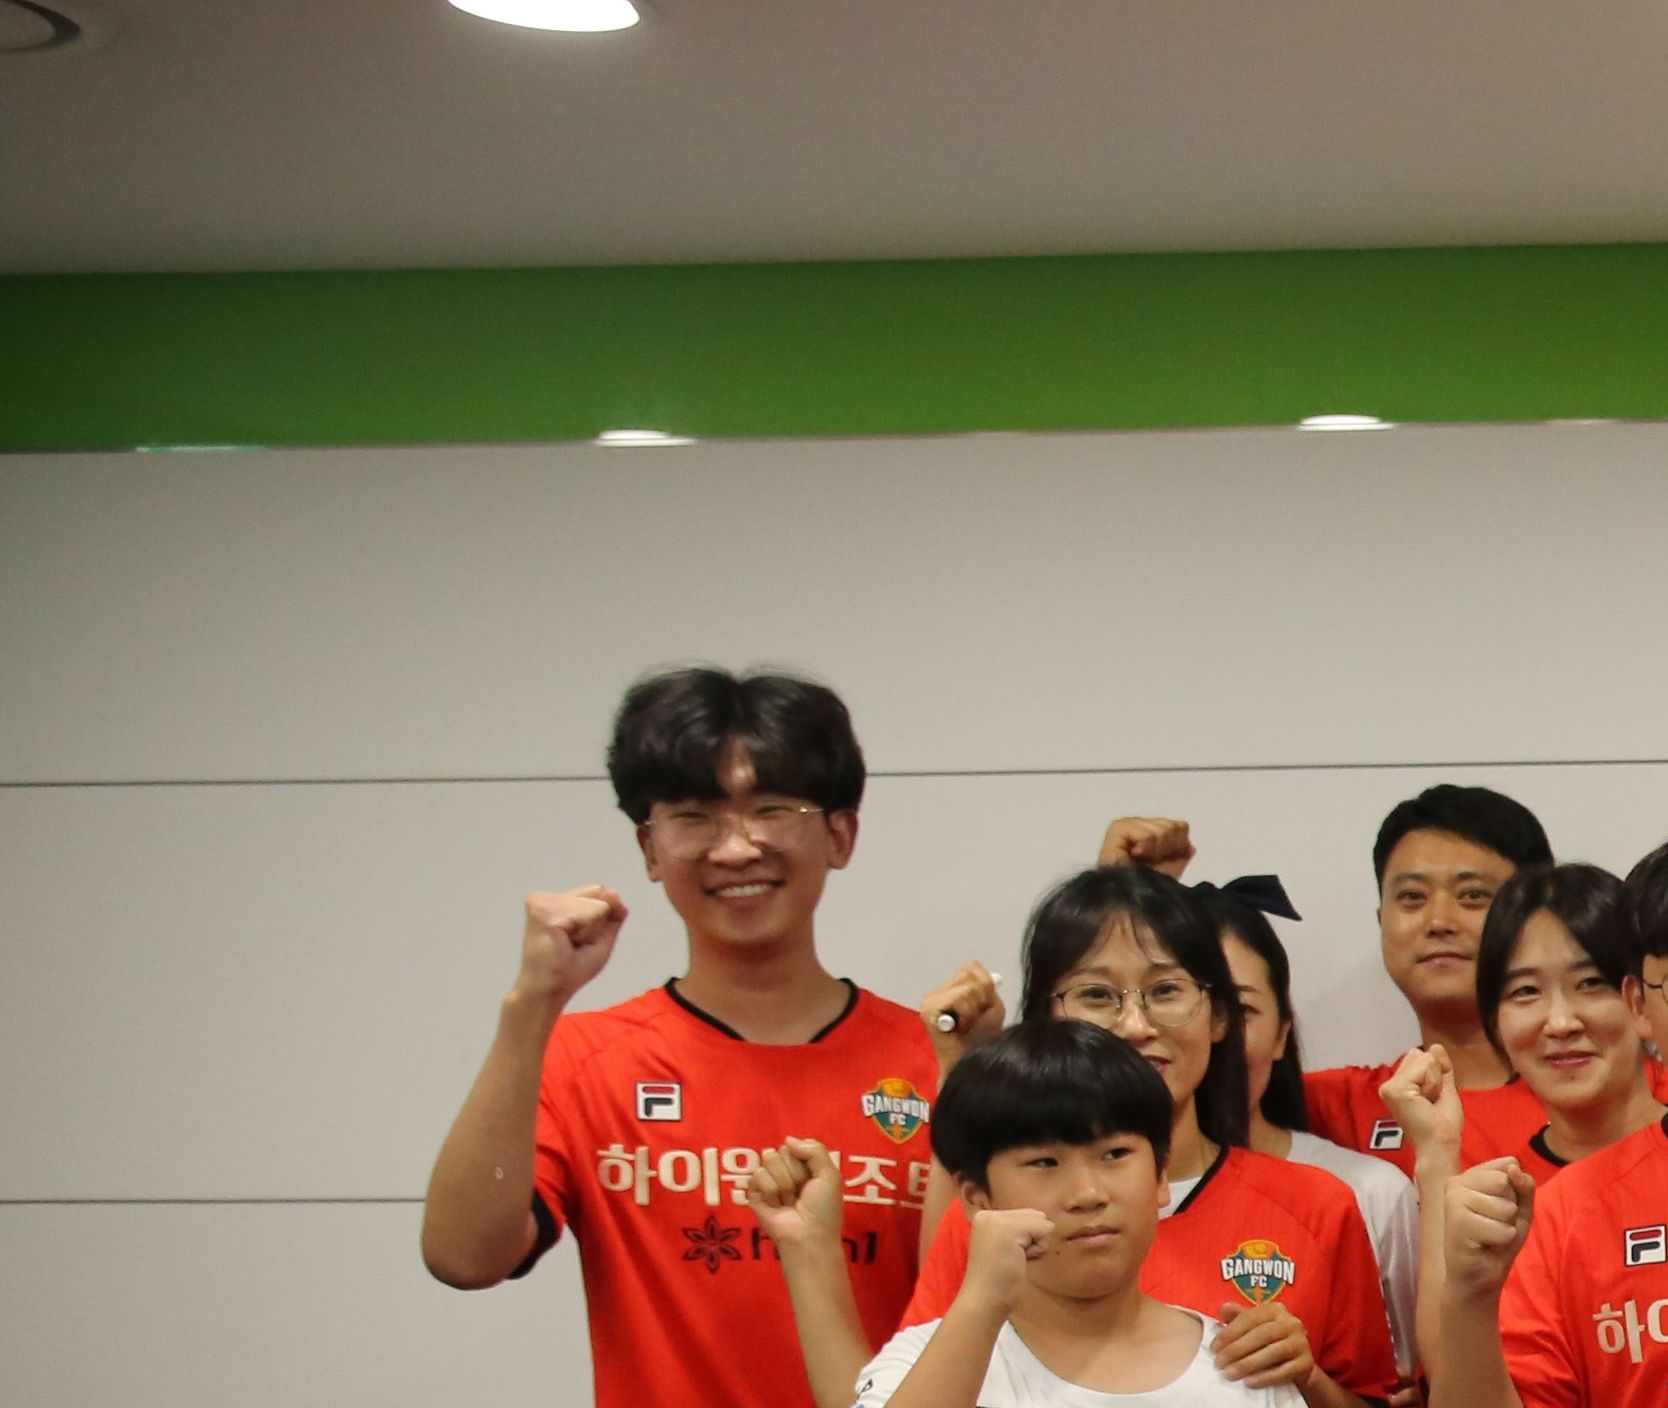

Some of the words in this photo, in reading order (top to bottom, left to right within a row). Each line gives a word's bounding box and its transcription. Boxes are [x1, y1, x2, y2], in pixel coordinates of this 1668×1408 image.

[861, 1094, 931, 1124] GANGWON
[888, 1113, 907, 1127] FC
[1220, 1258, 1295, 1285] GANGWON
[1250, 1274, 1268, 1288] FC
